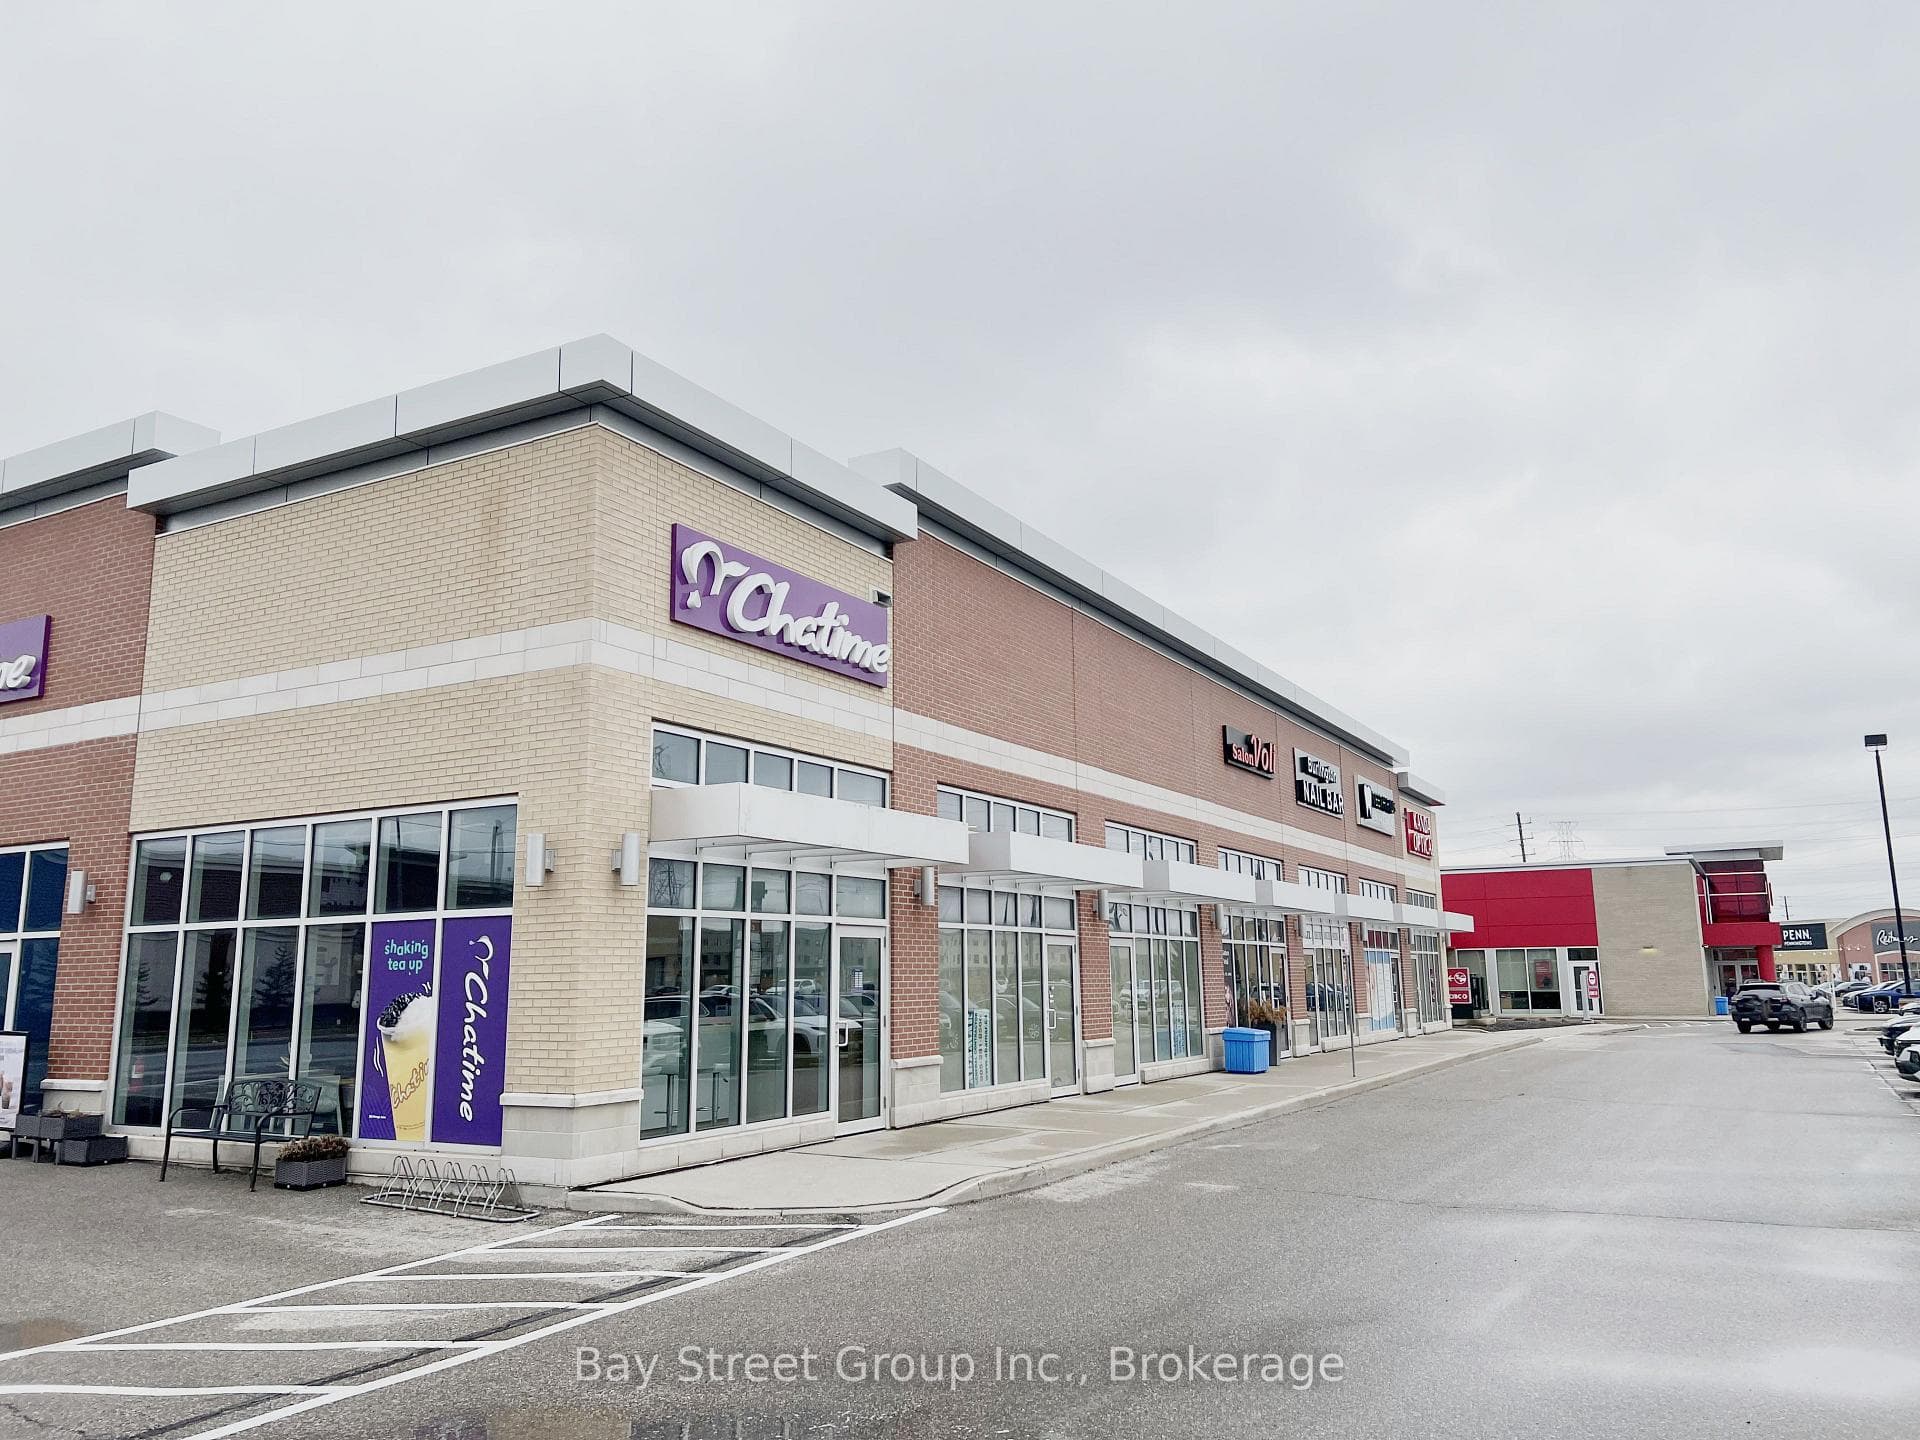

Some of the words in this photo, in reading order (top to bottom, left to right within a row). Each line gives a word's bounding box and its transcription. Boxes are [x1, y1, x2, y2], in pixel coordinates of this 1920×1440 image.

[726, 573, 891, 673] Chatime
[1232, 743, 1255, 767] Salon
[1302, 780, 1326, 808] NAIL
[1326, 787, 1345, 815] BAR
[1782, 928, 1812, 940] PENN.
[1876, 929, 1919, 946] Reitmns
[384, 940, 429, 958] shaking
[387, 958, 406, 971] tea
[408, 959, 423, 973] up
[458, 971, 488, 1122] Chatime
